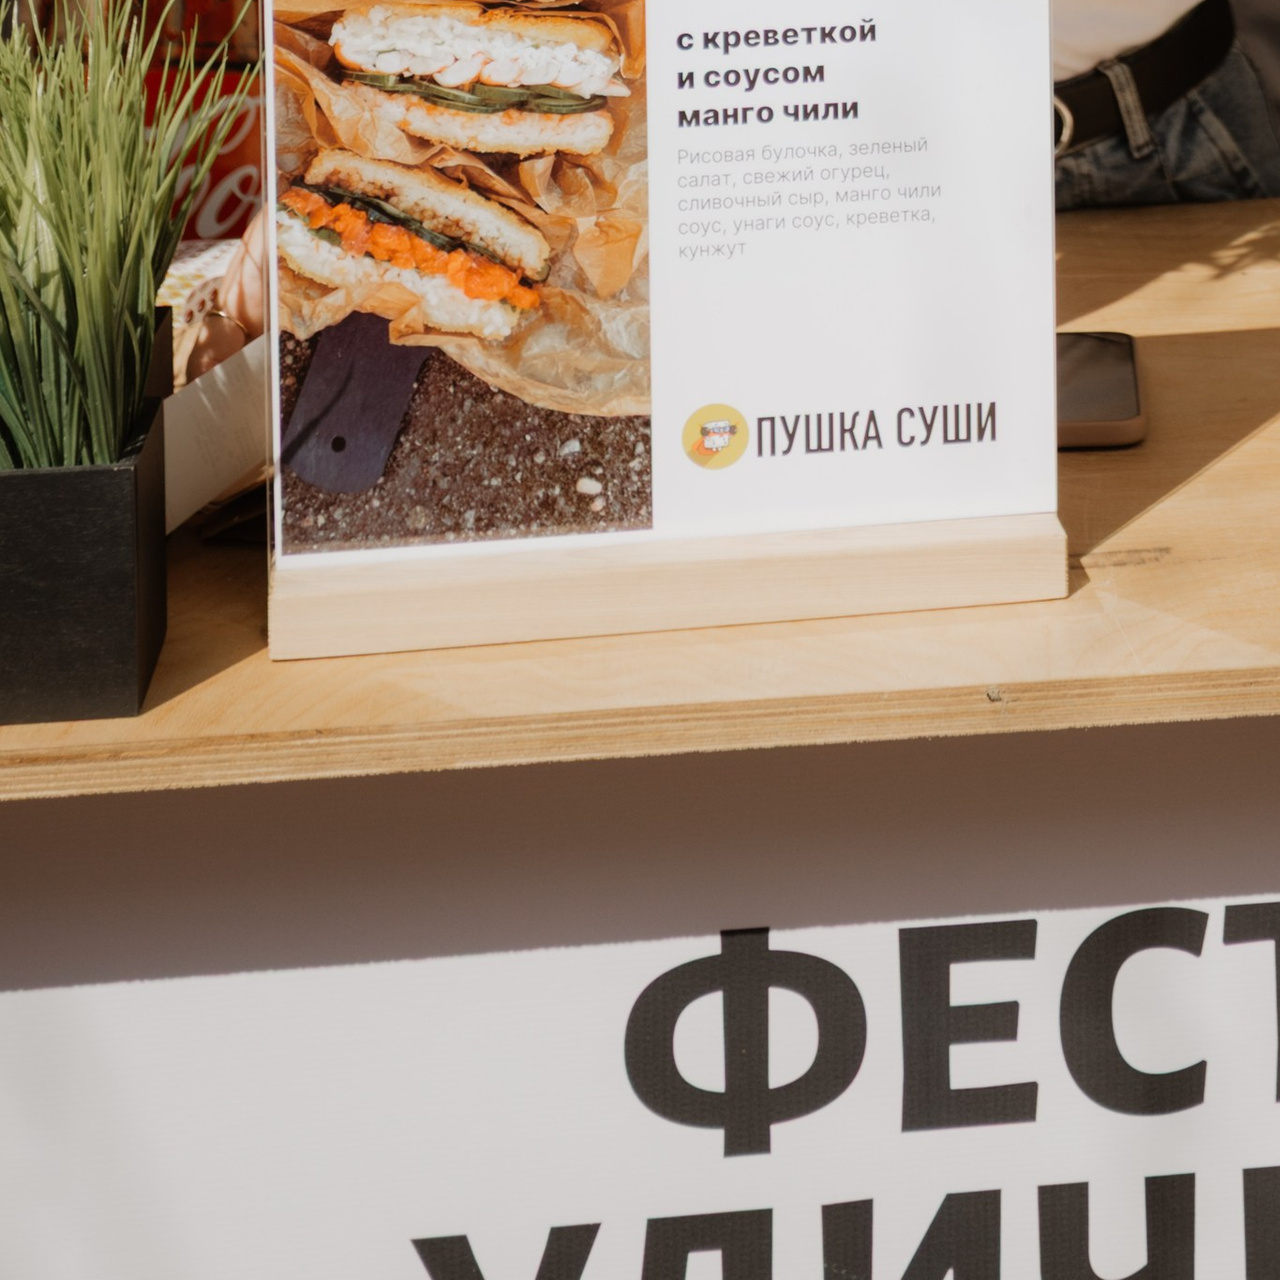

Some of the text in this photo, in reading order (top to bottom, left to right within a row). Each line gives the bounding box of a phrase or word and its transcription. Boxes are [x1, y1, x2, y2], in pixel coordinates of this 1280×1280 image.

[675, 17, 877, 56] с креветкой
[676, 64, 826, 94] и соусом
[677, 100, 860, 129] манго чили
[677, 136, 928, 165] Рисовая булочка, зеленый
[677, 164, 890, 189] салат, свежий огурец,
[677, 183, 942, 212] сливочный сыр, манго чили
[677, 207, 936, 238] соус, унаги соус, креветка,
[678, 240, 747, 262] кунжут
[756, 400, 998, 459] ПУШКА СУШИ
